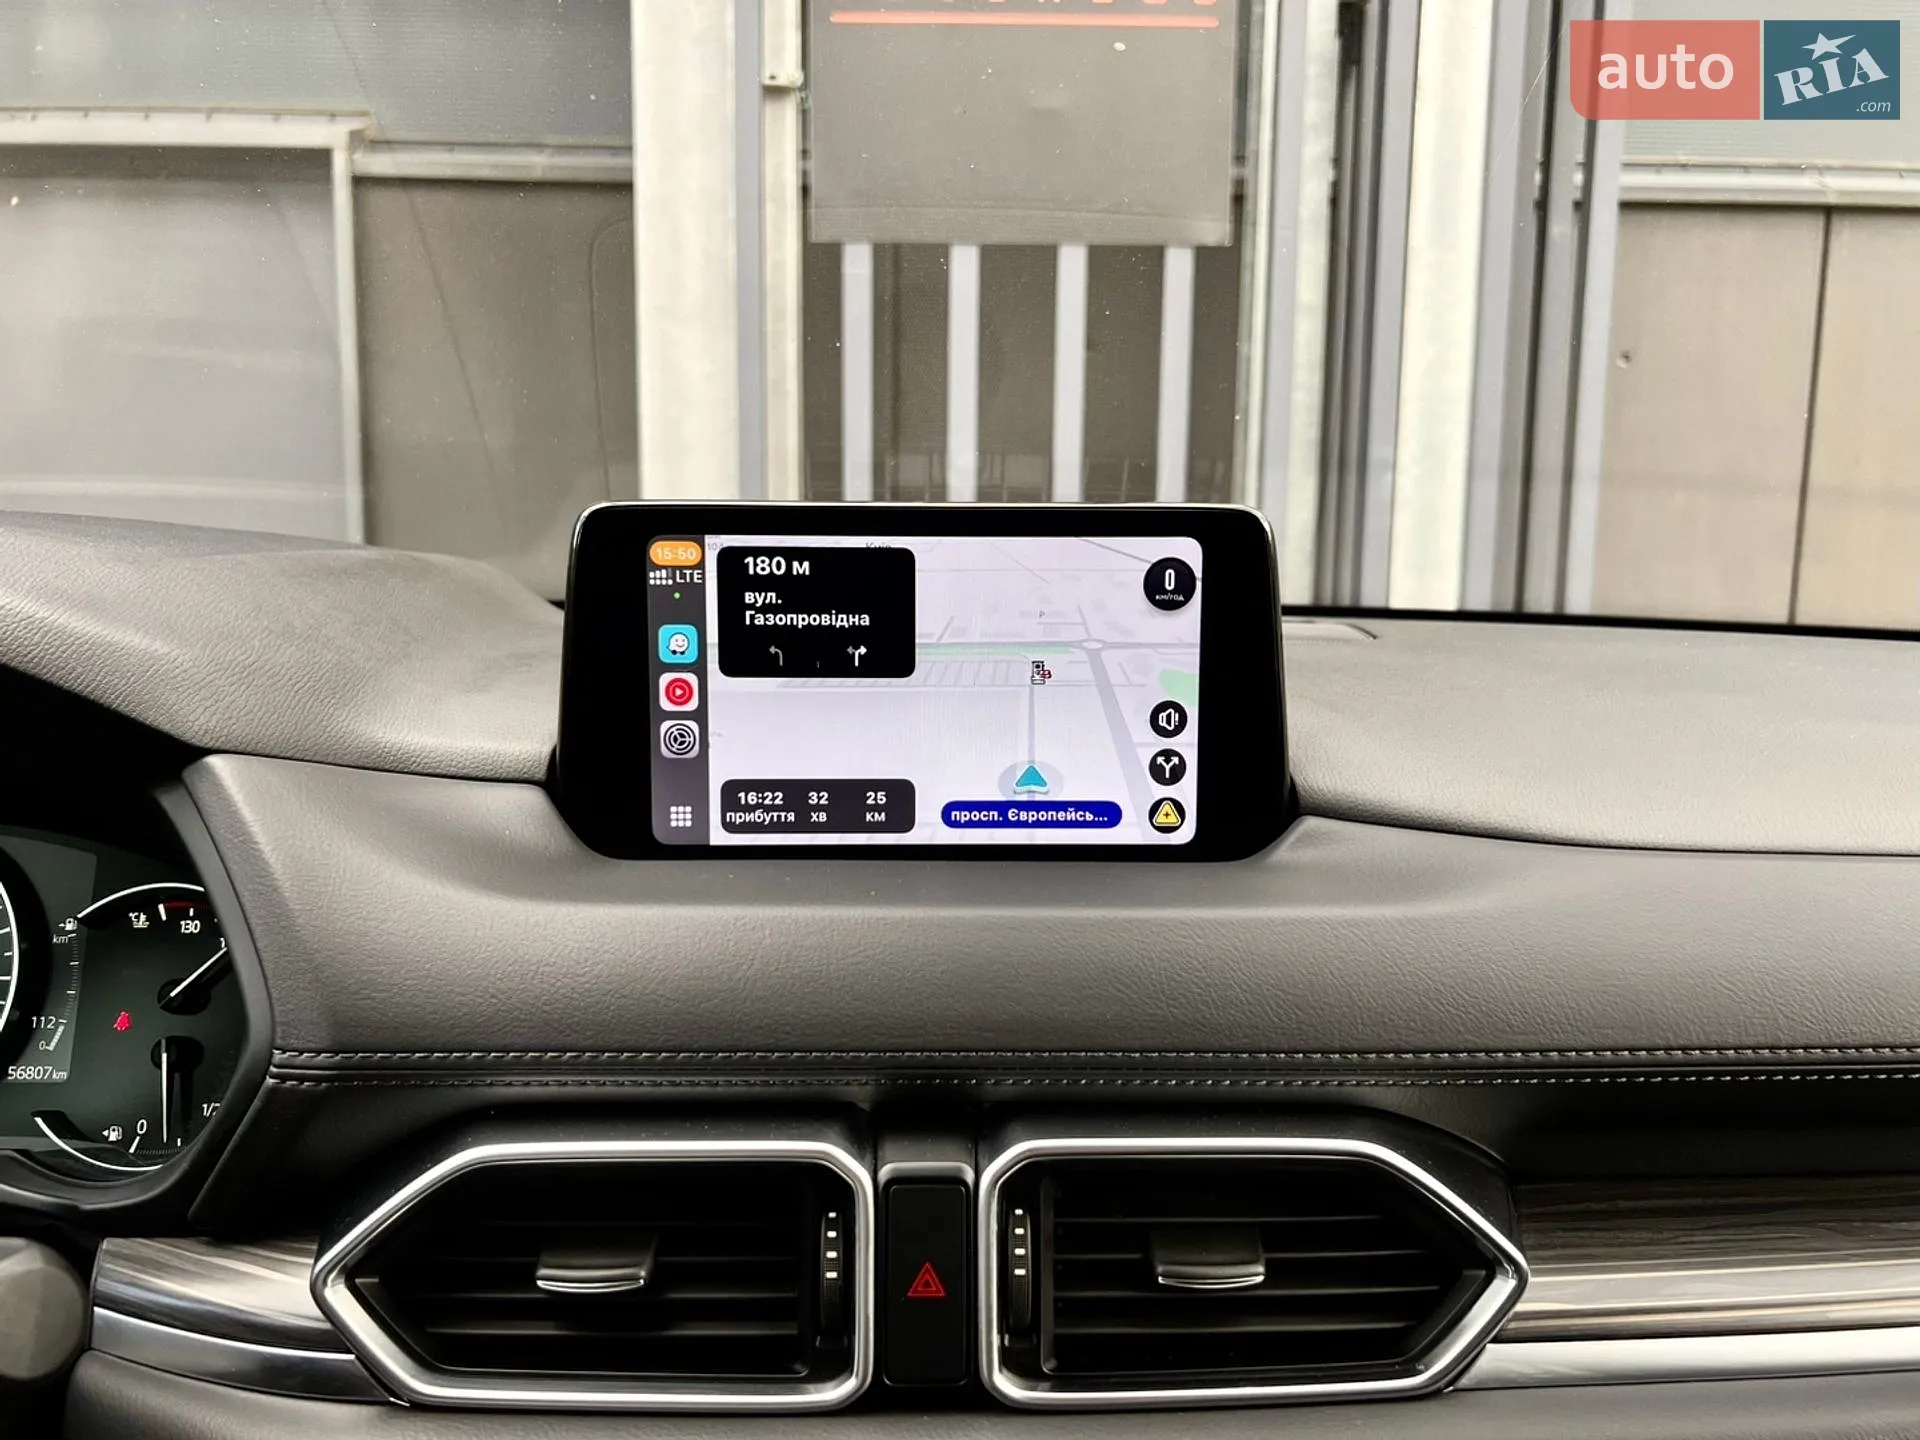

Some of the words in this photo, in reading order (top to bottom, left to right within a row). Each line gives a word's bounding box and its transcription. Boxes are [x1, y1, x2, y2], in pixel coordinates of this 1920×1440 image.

[656, 547, 697, 560] 15:50
[744, 555, 787, 576] 180
[792, 560, 810, 576] м
[675, 569, 703, 583] LTE
[1164, 568, 1176, 591] 0
[744, 591, 783, 605] вул.
[745, 609, 870, 629] Газопровідна
[737, 791, 784, 805] 16:22
[808, 791, 829, 805] 32
[866, 791, 887, 805] 25
[726, 809, 795, 824] прибуття
[810, 812, 828, 823] хв
[865, 811, 886, 823] км
[951, 809, 1003, 824] просп.
[179, 919, 201, 934] 130
[52, 934, 68, 944] km
[31, 1016, 56, 1029] 112
[38, 1040, 46, 1051] 0
[136, 1118, 147, 1135] 0
